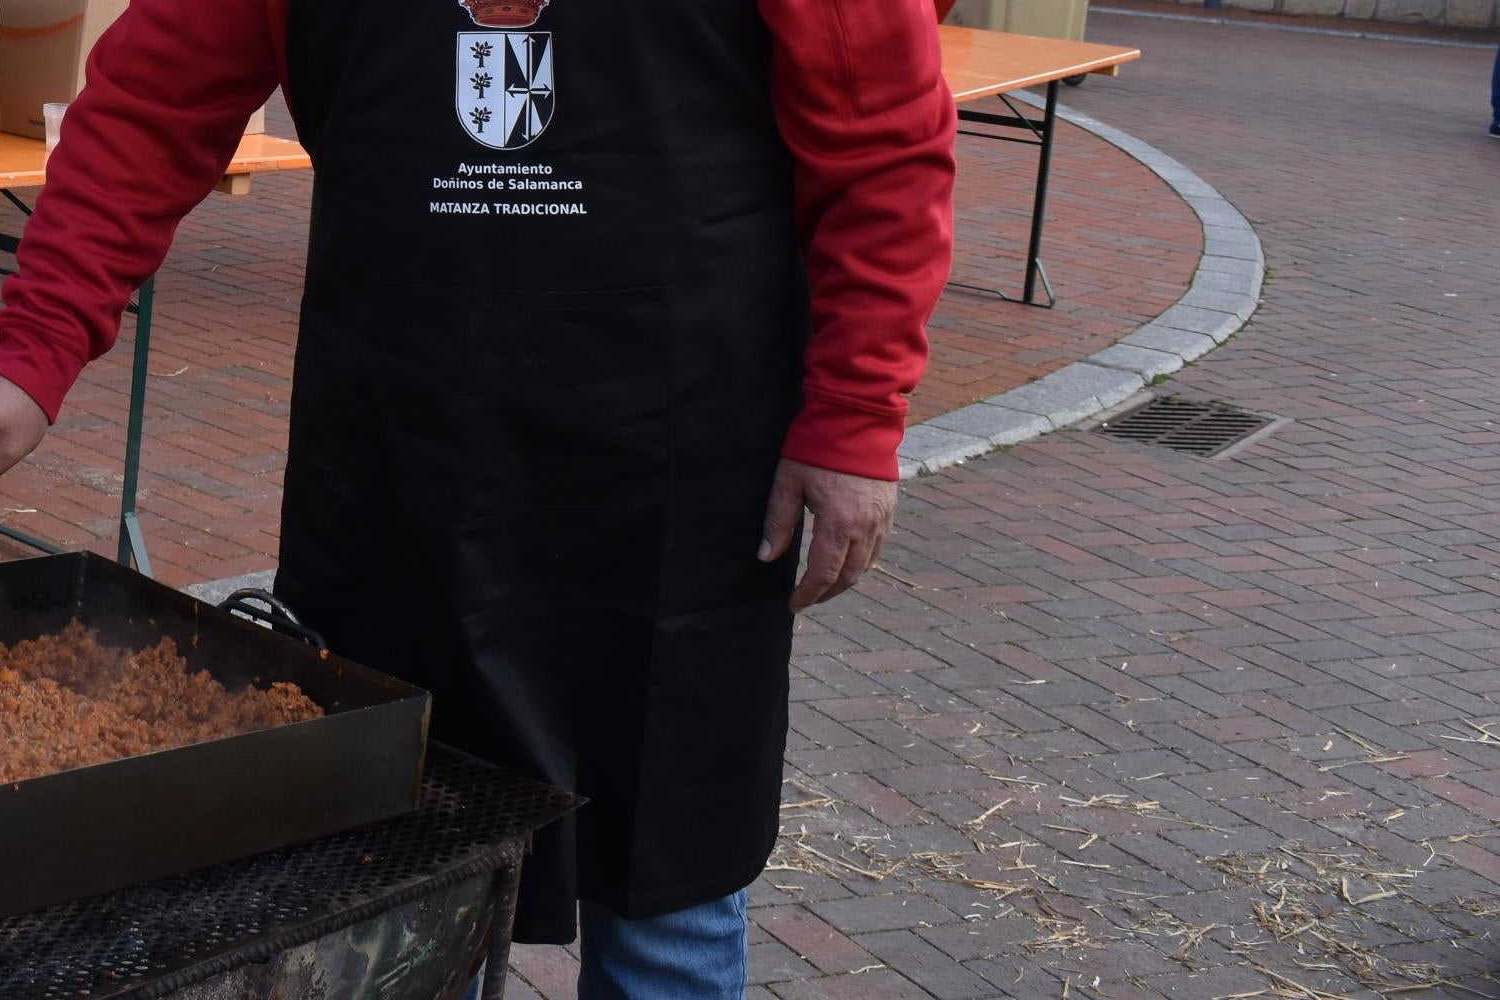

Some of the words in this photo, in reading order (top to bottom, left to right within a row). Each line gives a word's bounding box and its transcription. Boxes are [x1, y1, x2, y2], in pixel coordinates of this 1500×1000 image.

[458, 162, 553, 177] Ayuntamiento
[432, 177, 484, 189] Doñinos
[487, 178, 504, 190] de
[508, 178, 583, 190] Salamanca
[429, 202, 490, 215] MATANZA
[493, 203, 587, 215] TRADICIONAL
